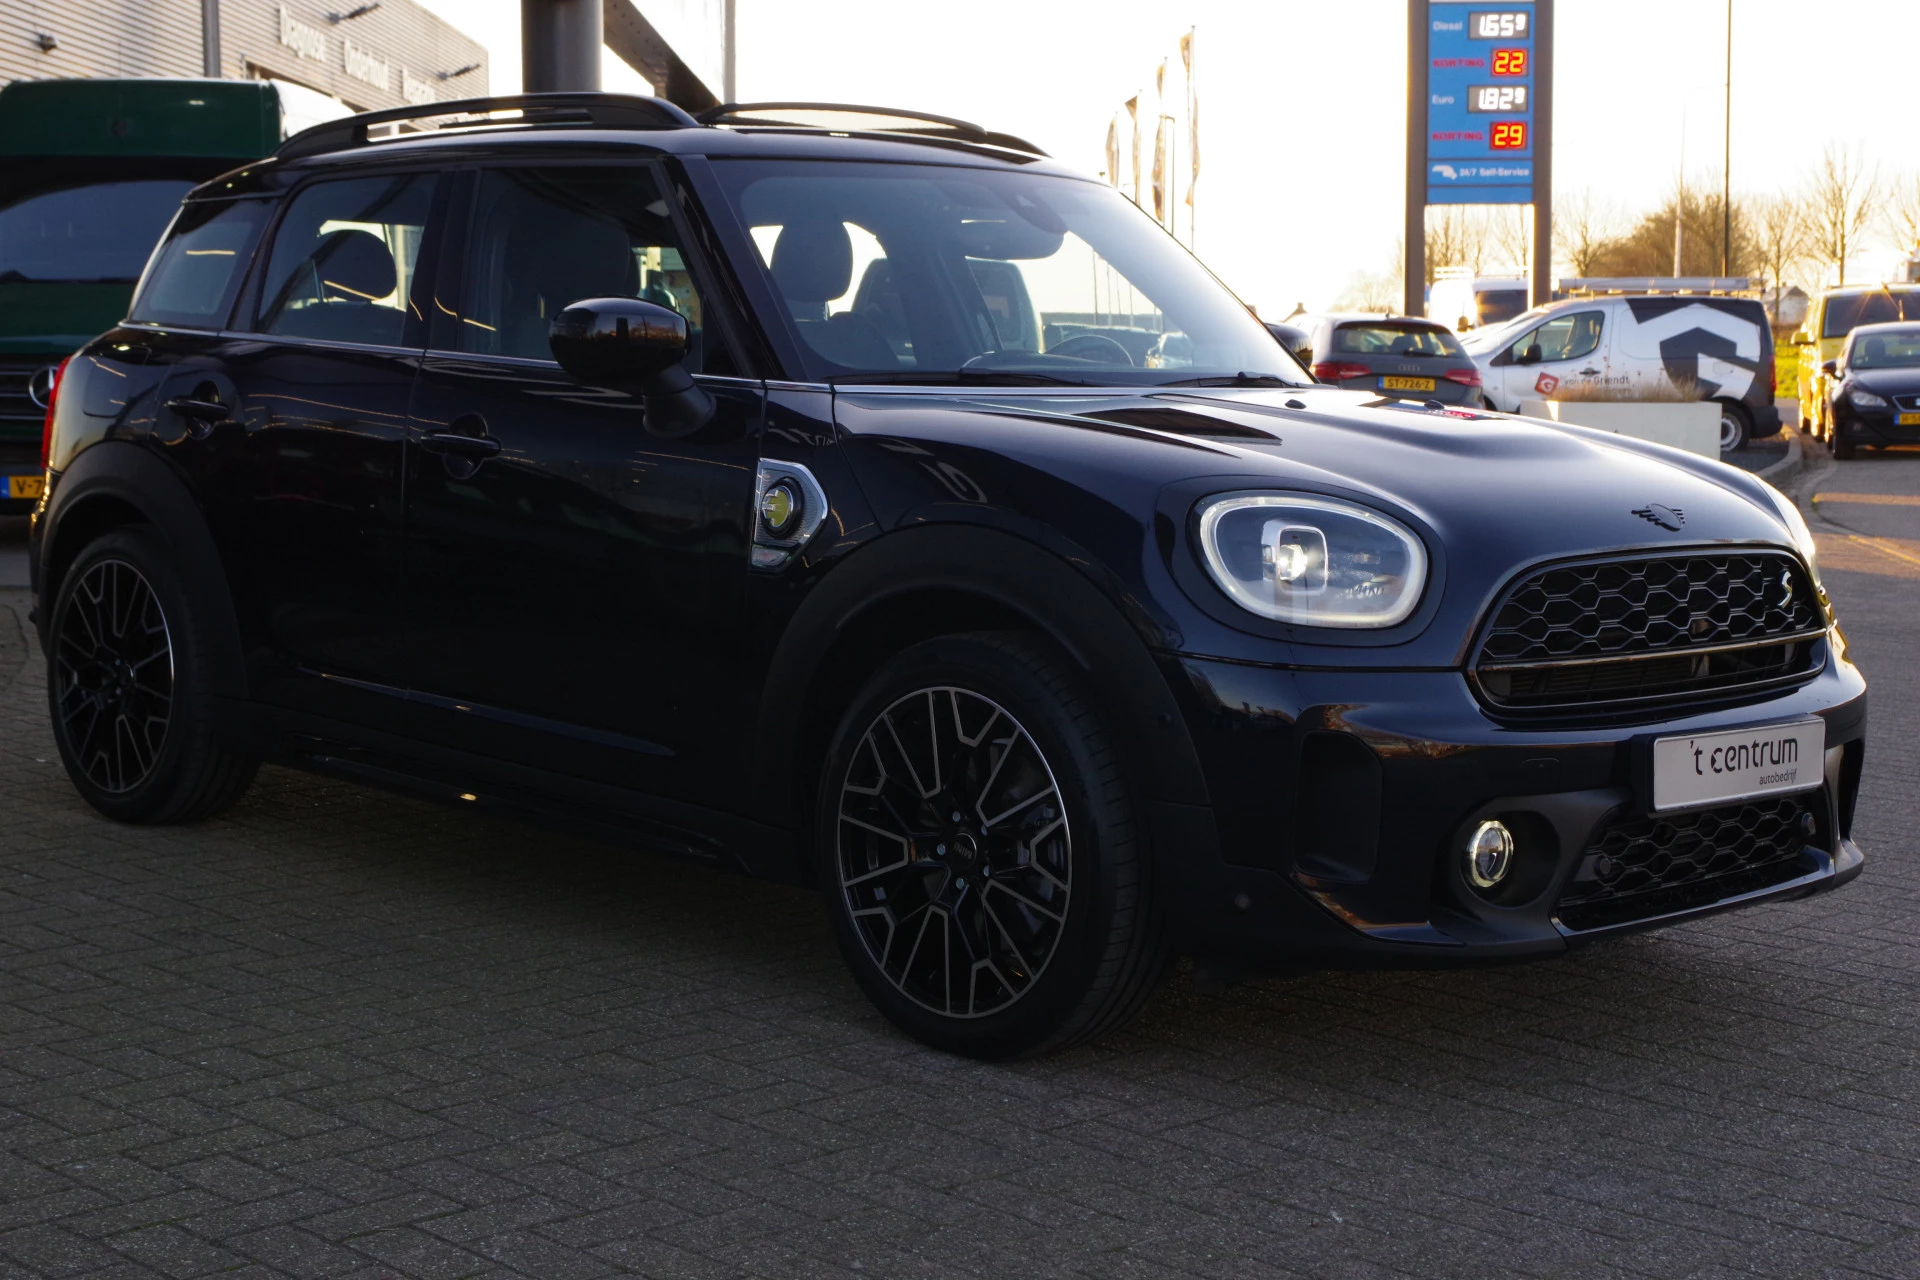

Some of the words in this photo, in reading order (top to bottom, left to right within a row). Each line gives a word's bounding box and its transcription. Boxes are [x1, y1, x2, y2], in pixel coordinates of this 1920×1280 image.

[1433, 21, 1463, 31] Diesel
[1433, 59, 1485, 67] KORTING
[1494, 51, 1524, 73] 22
[1432, 95, 1454, 104] Euro
[1432, 132, 1484, 141] KORTING
[1494, 125, 1523, 146] 29
[1460, 168, 1477, 176] 24/7
[1388, 378, 1430, 389] ST-726-Z
[1690, 740, 1703, 775] 't
[1711, 738, 1798, 773] centrum
[1759, 768, 1797, 784] autobedrijf
